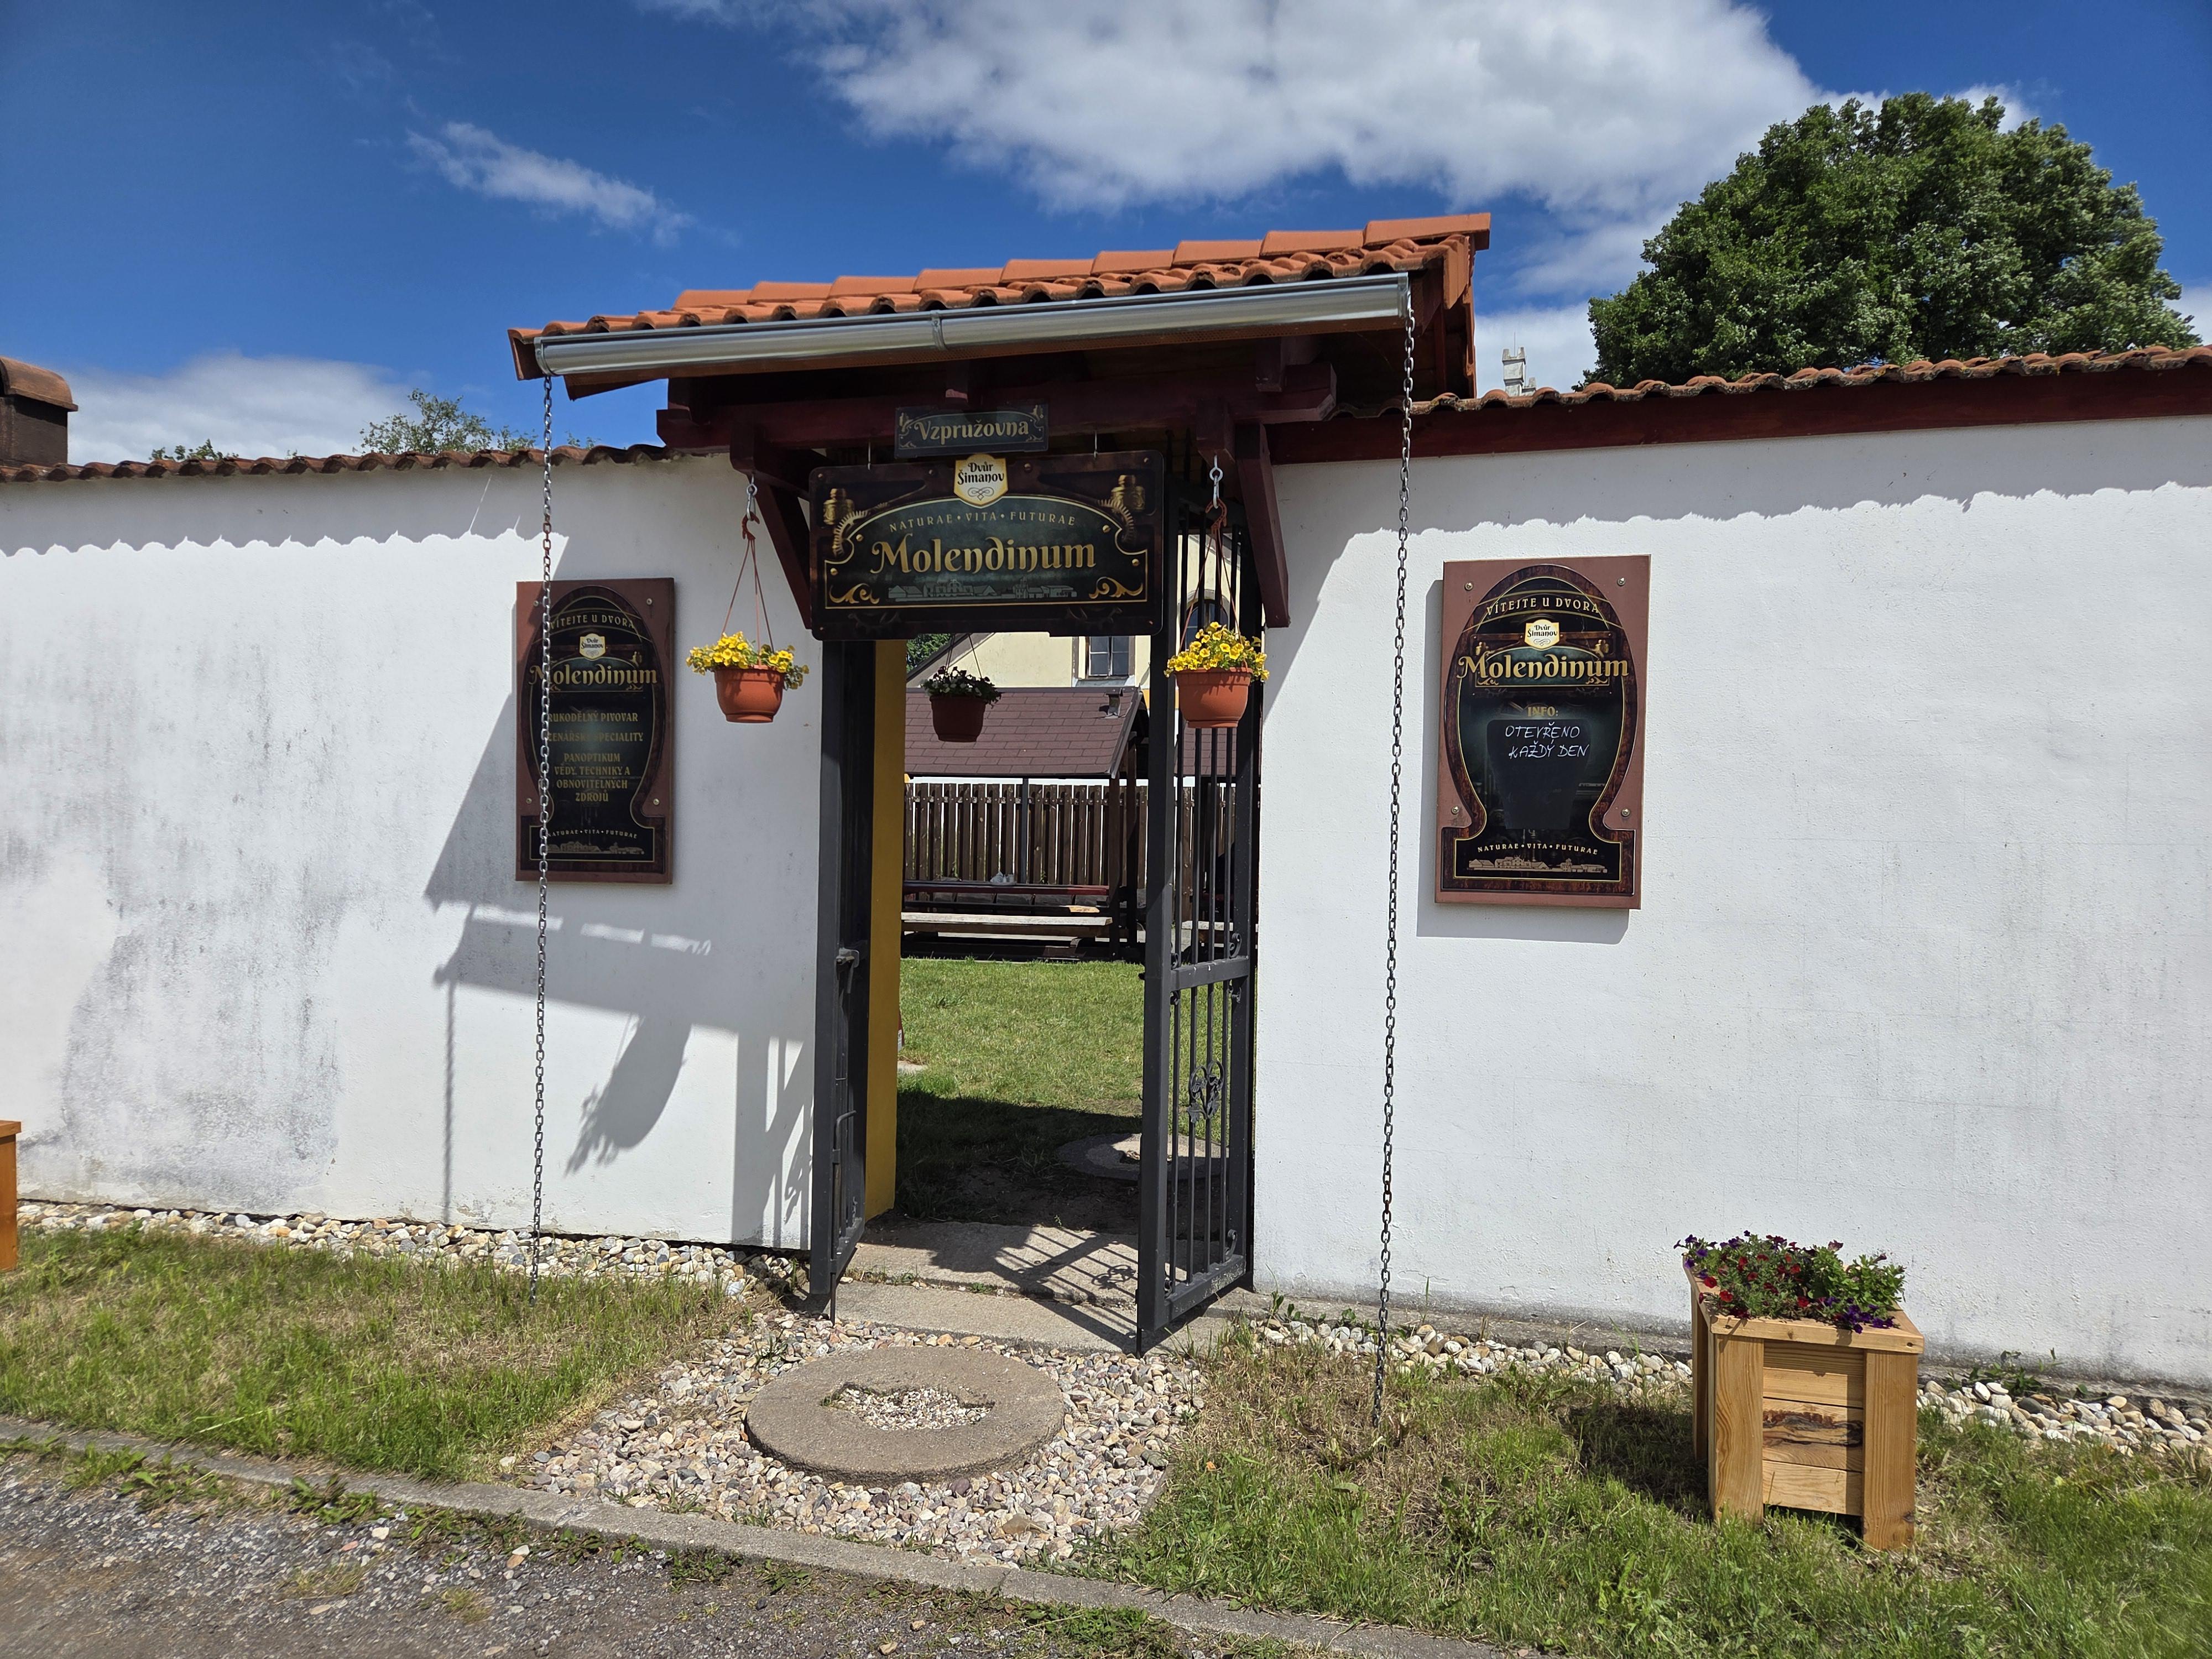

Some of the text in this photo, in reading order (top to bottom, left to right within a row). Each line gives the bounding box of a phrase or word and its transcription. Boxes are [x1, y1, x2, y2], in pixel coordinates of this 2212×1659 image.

[914, 419, 1029, 445] Vzpružovna
[968, 461, 993, 473] Dvůr
[957, 469, 1004, 485] Šimanov
[889, 512, 1076, 533] NATURAE VITA FUTURAE
[869, 533, 1097, 574] Molendinum
[1486, 598, 1600, 615] VÍTEJTE U DVORA
[591, 614, 598, 623] U
[602, 614, 635, 629] DVORA
[1527, 629, 1558, 638] Šimanov
[1456, 651, 1629, 680] Molendinum
[601, 712, 638, 722] PIVOVAR
[1527, 706, 1559, 717] INFO:
[1505, 722, 1580, 739] OTEVŘENO
[1508, 739, 1589, 759] KAŽDÝ DEN
[564, 753, 620, 763] PANOPTIKUM
[579, 766, 623, 775] TECHNIKY
[624, 766, 630, 775] A
[556, 778, 628, 789] OBNOVITELNÝCH
[575, 790, 608, 802] ZDROJŮ
[1477, 843, 1519, 853] NATURAE
[1556, 844, 1598, 855] FUTURAE
